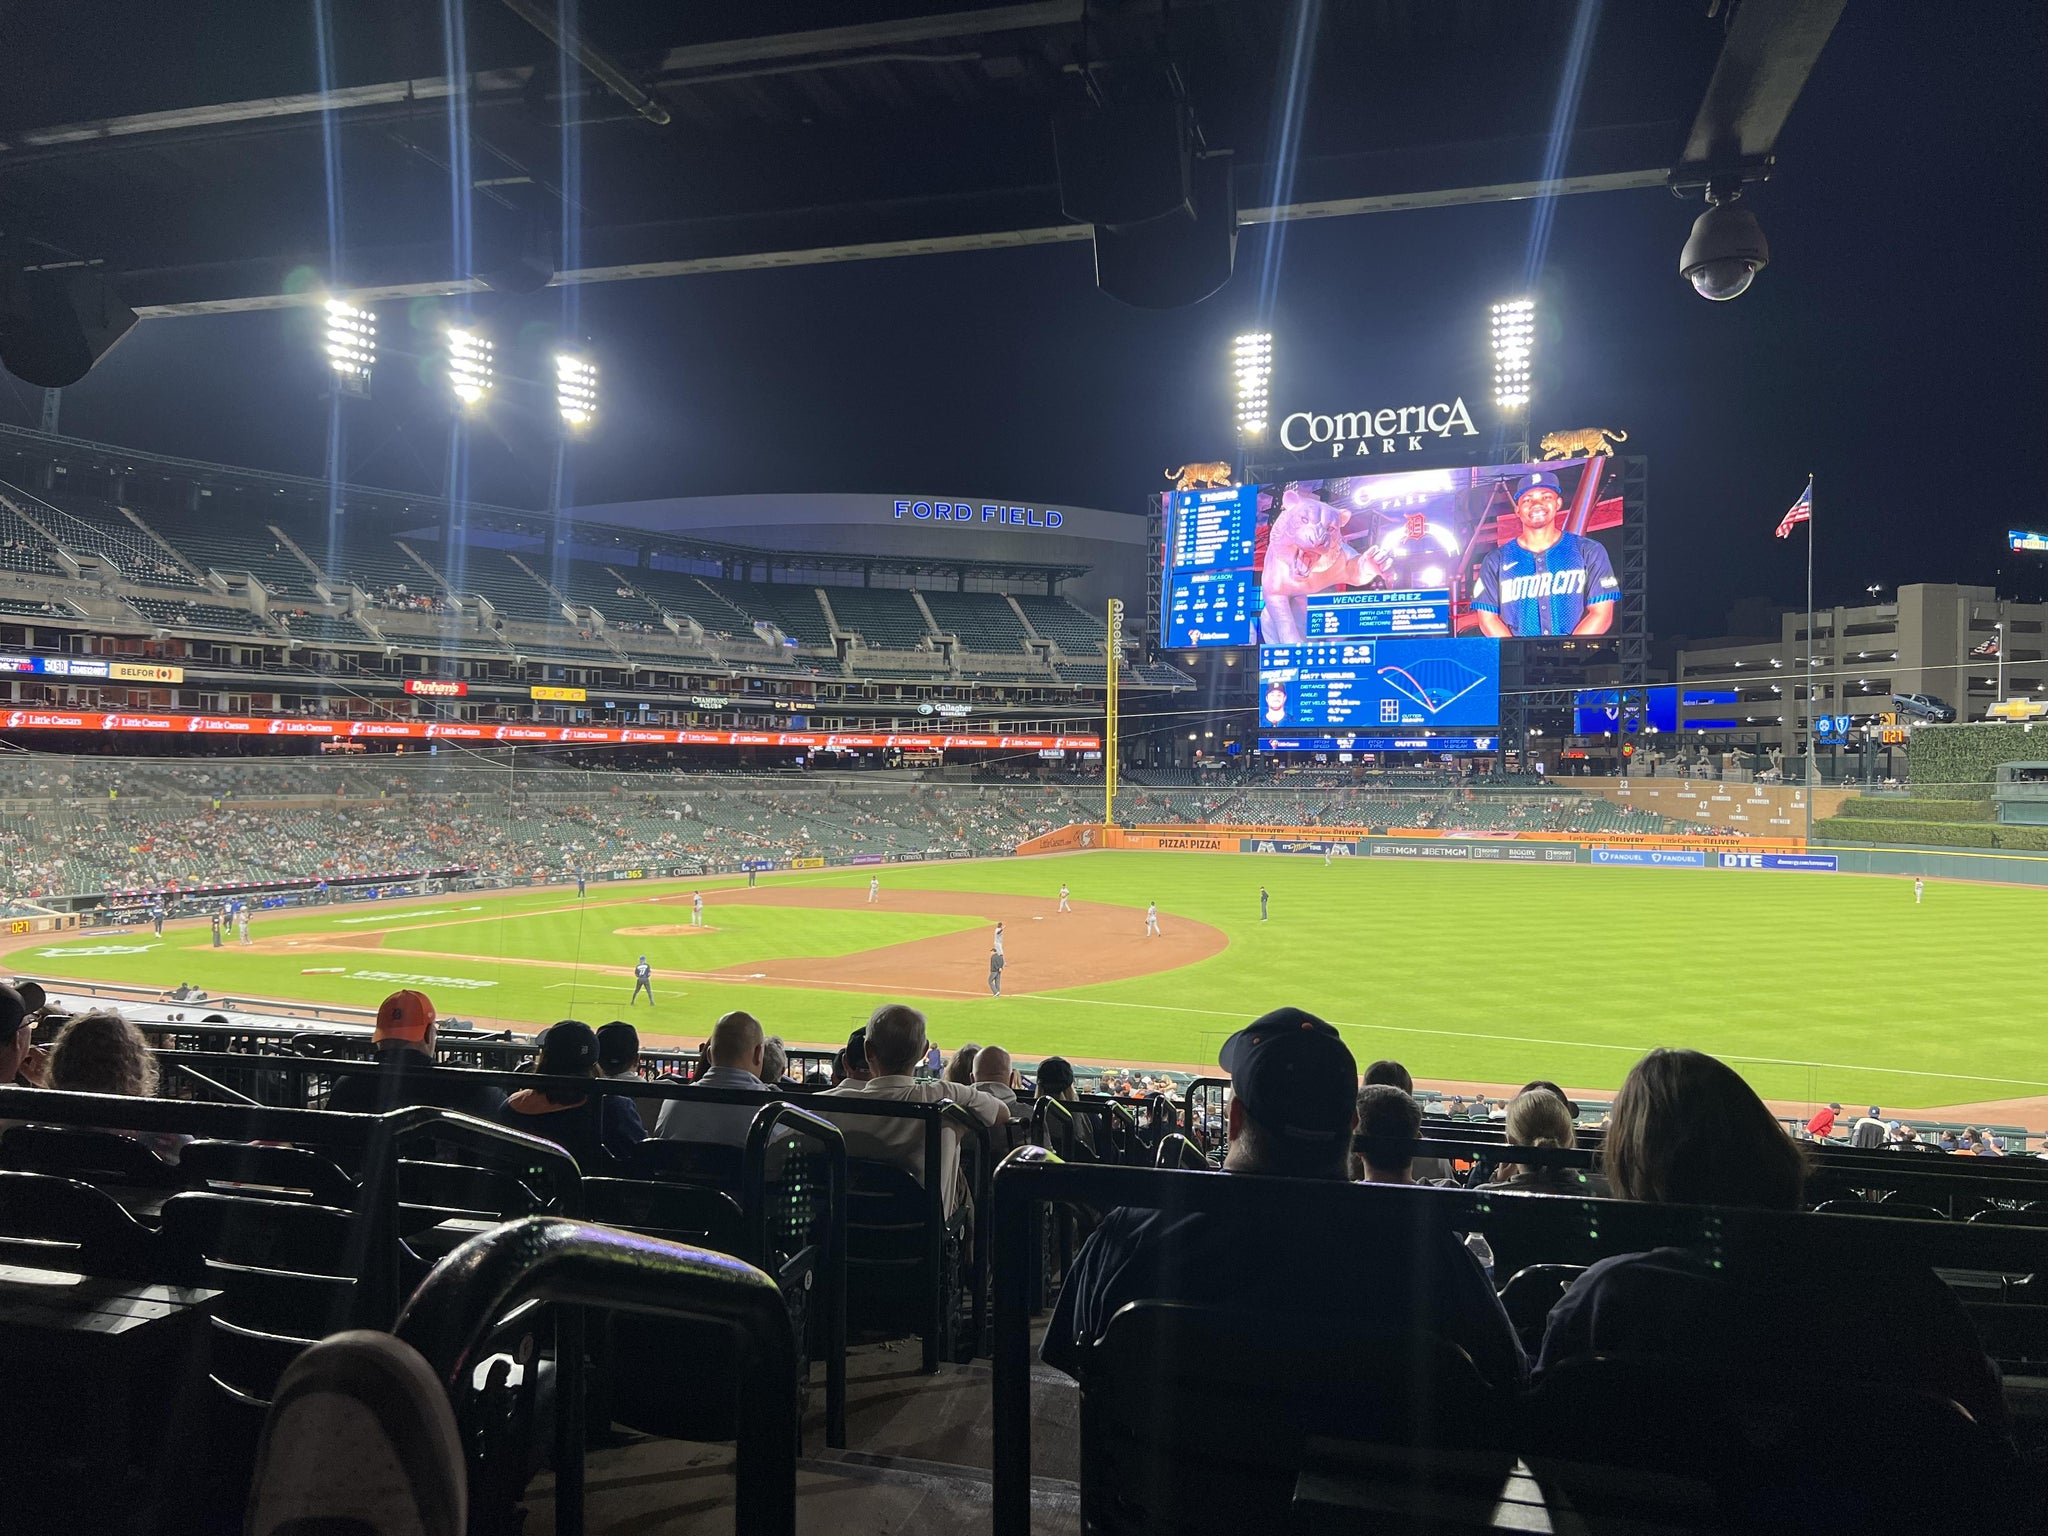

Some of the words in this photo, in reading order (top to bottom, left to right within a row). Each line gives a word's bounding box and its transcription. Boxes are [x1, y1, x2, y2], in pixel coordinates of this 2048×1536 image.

[1332, 436, 1423, 458] PARK
[894, 500, 973, 522] FORD
[981, 504, 1064, 529] FIELD
[1552, 569, 1587, 595] CITY
[1333, 595, 1380, 604] WENCEEL
[1383, 593, 1421, 602] PÉREZ
[1113, 612, 1125, 660] Rocket
[121, 669, 154, 677] BELFOR
[412, 680, 459, 693] Dunham's
[692, 696, 728, 705] CHAMPIONS
[935, 703, 972, 713] Gallagher
[29, 716, 50, 725] Little
[51, 717, 82, 726] Caesars
[122, 718, 141, 727] Little
[142, 719, 170, 728] Caesars
[205, 721, 223, 729] Little
[224, 722, 249, 731] Caesars
[287, 723, 305, 732] Little
[306, 724, 332, 733] Caesars
[367, 725, 383, 733] Little
[384, 726, 409, 734] Caesars
[440, 727, 456, 735] Little
[457, 728, 480, 736] Caesars
[510, 729, 525, 737] Little
[526, 730, 546, 738] Caesars
[574, 731, 587, 739] Little
[1620, 780, 1629, 789] 23
[1684, 782, 1689, 790] 5
[1718, 785, 1724, 794] 2
[1754, 787, 1763, 797] 16
[1795, 791, 1801, 800] 6
[1698, 801, 1708, 810] 47
[1736, 804, 1741, 813] 3
[1778, 807, 1782, 816] 1
[1159, 839, 1189, 849] PIZZA!
[1190, 840, 1221, 850] PIZZA!
[1429, 848, 1466, 856] BETMGM
[1724, 854, 1762, 867] DTE
[614, 870, 642, 879] bet365
